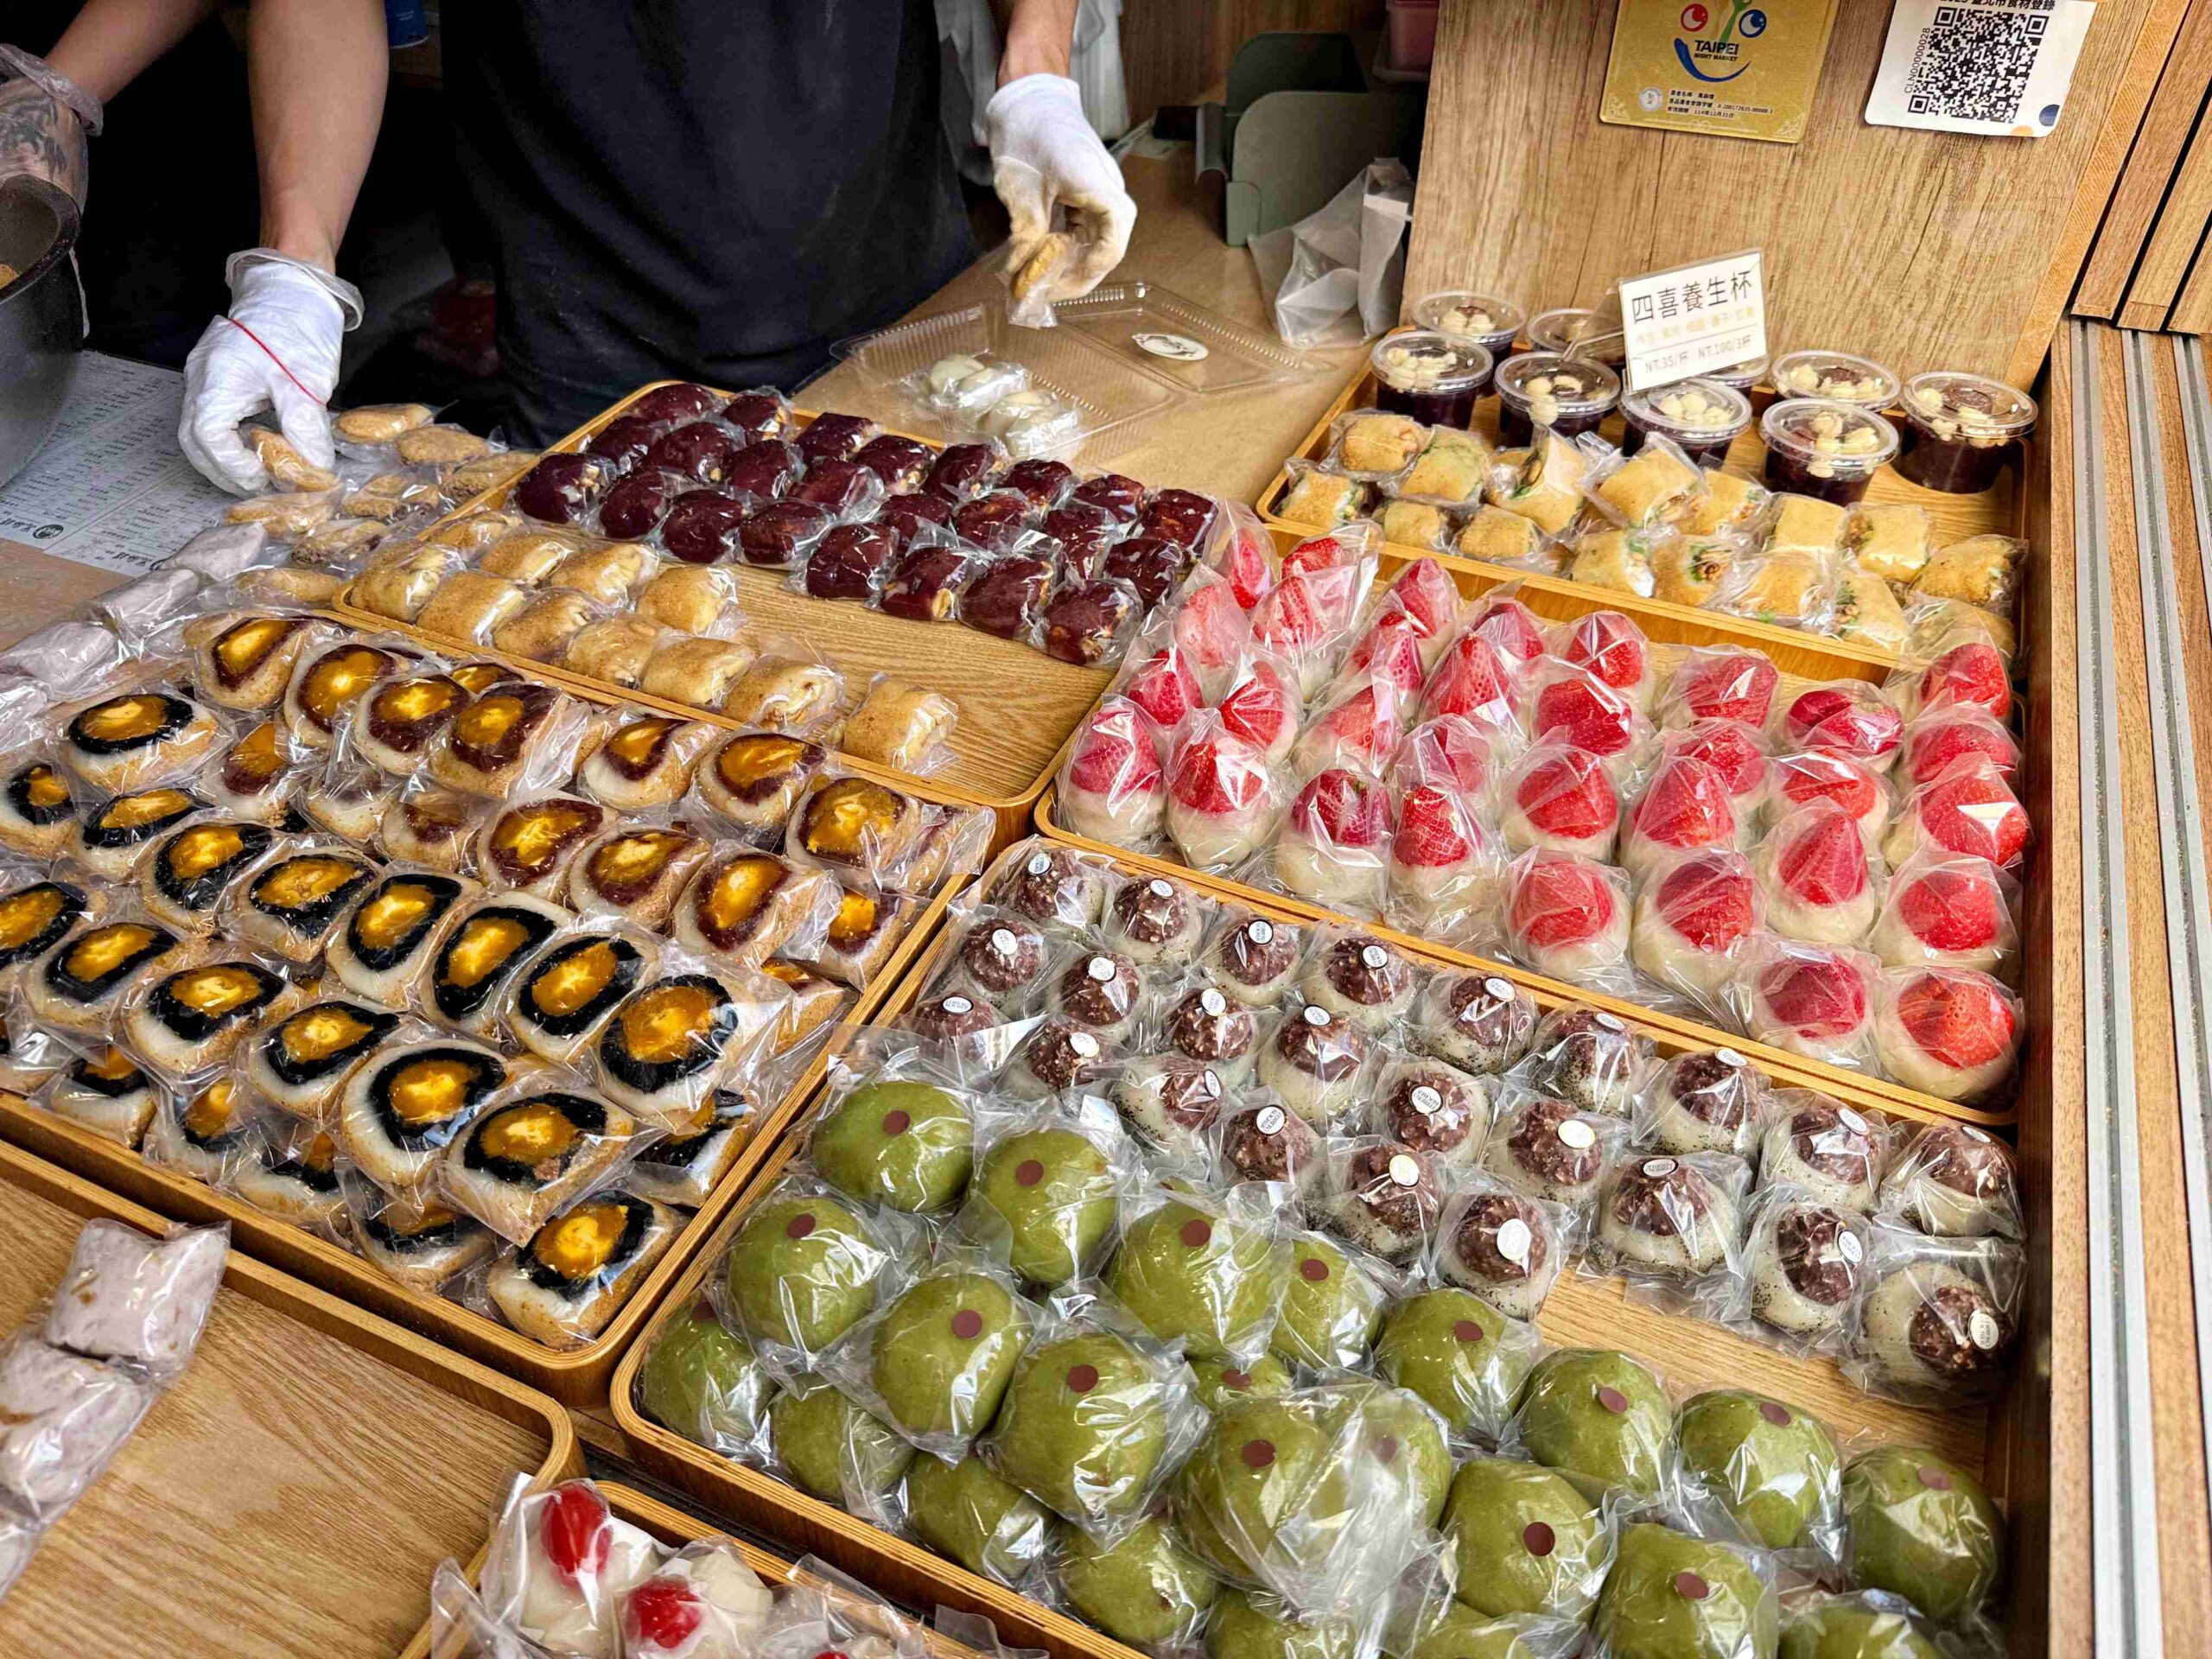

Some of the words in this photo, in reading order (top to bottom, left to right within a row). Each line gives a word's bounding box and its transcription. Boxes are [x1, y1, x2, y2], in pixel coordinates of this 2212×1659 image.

[1694, 40, 1739, 55] TAIPEI
[1904, 28, 1931, 94] CLN00000028
[1631, 270, 1752, 325] 四喜養生杯
